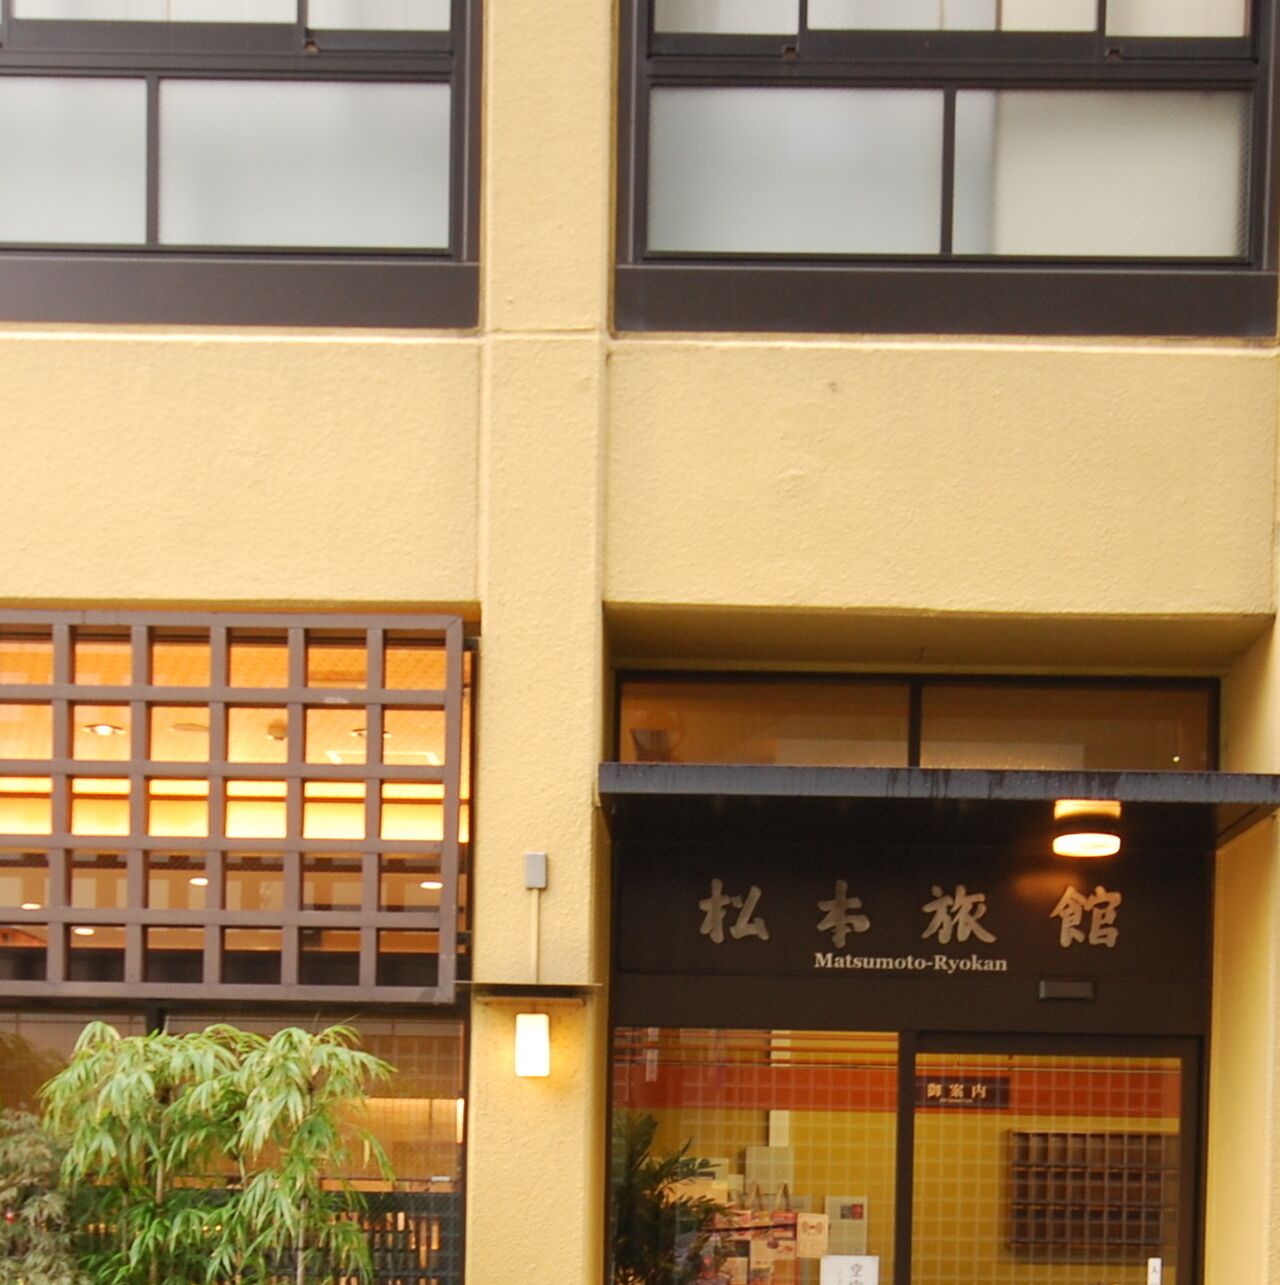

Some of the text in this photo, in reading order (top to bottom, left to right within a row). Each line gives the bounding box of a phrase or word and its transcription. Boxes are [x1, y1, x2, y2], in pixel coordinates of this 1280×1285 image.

[700, 879, 1121, 947] 松本旅館
[813, 952, 1009, 975] Matsumoto-Ryokan
[926, 1082, 987, 1098] 御案内
